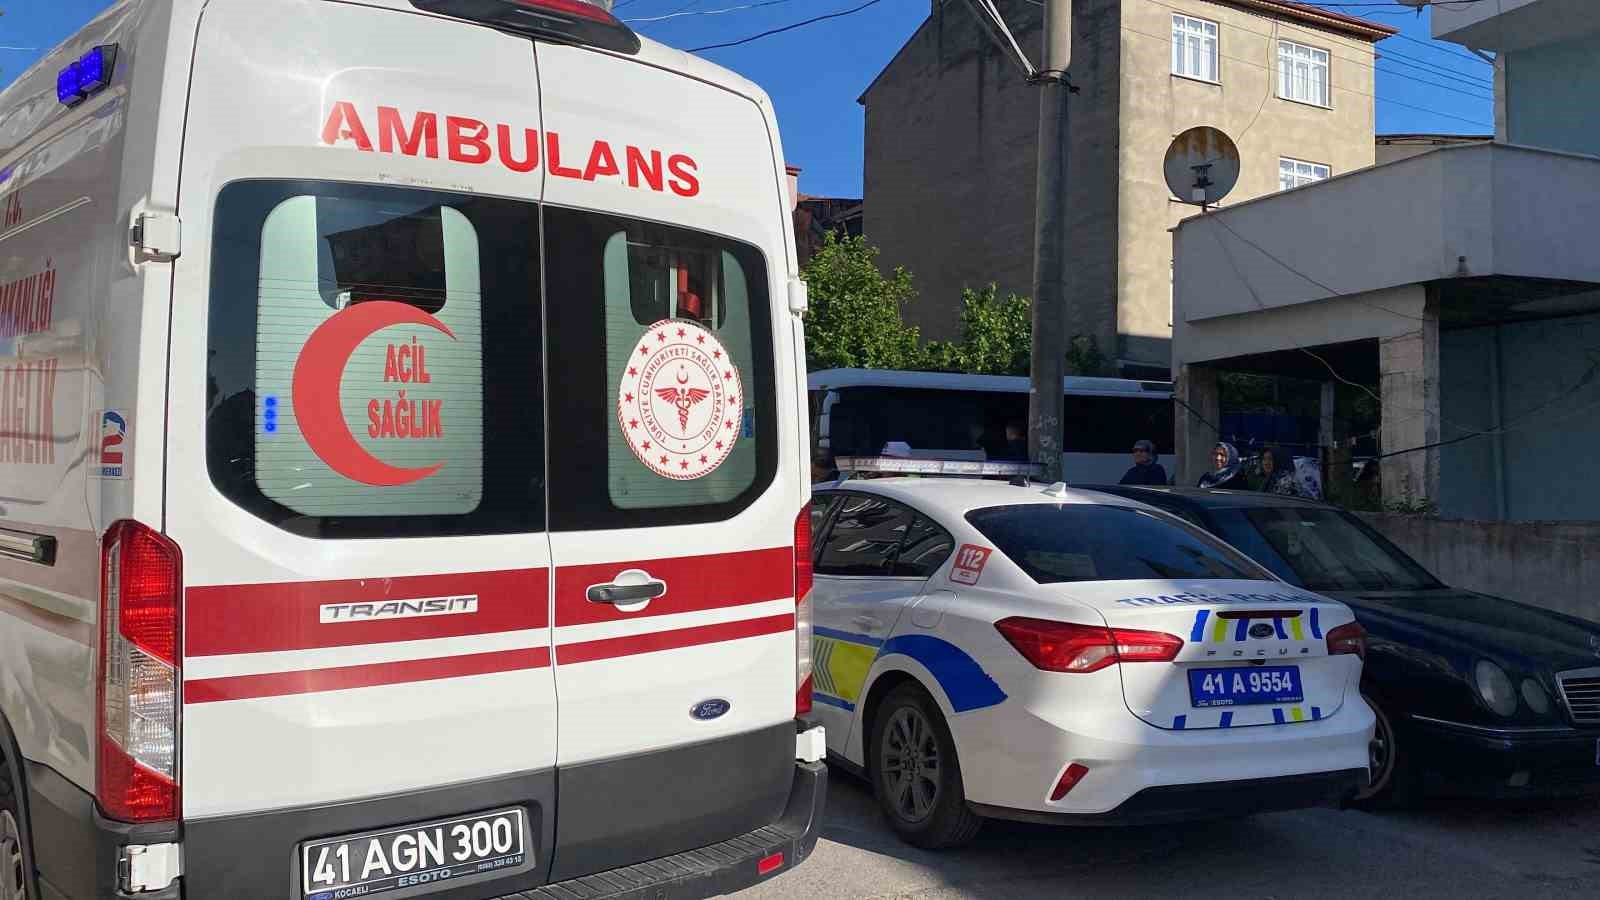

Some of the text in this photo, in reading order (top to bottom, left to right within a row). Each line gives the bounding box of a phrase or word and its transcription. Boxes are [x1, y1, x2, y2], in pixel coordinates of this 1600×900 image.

[320, 101, 700, 198] AMBULANS
[384, 335, 432, 384] ACİL
[367, 388, 444, 439] SAĞLIK
[641, 347, 723, 444] TÜRKİYE CUMHURİYETİ SAĞLIK BAKANLIĞI
[960, 548, 984, 569] 112
[325, 597, 477, 619] TRANSIT
[1206, 648, 1310, 657] FOCUS
[1202, 671, 1292, 695] 41 A 9554
[312, 816, 514, 885] 41 AGN 300
[398, 868, 451, 888] ESOTO
